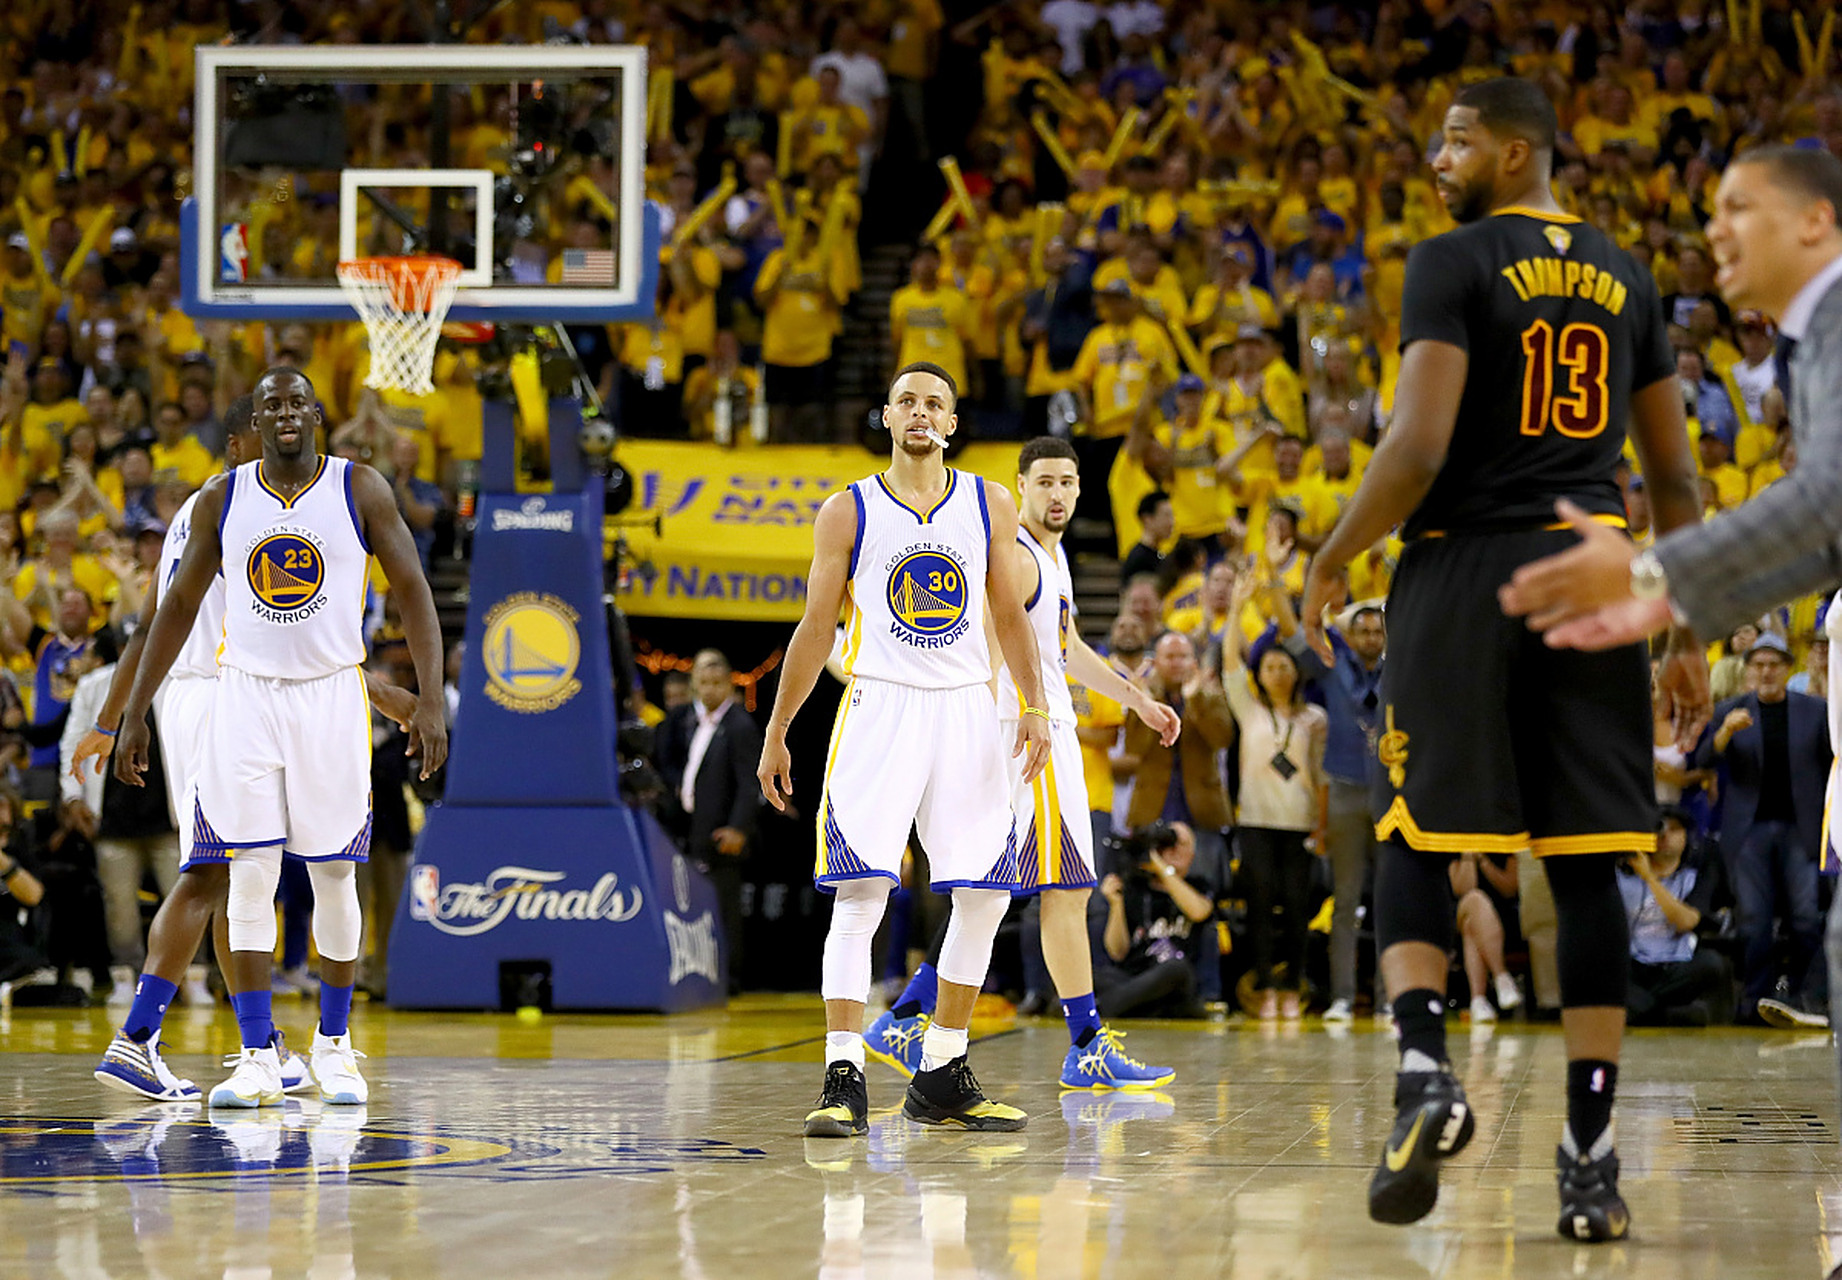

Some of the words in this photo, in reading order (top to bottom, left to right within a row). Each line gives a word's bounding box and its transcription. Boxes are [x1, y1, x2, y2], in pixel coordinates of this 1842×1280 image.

[1501, 256, 1627, 316] THOMPSON
[1519, 318, 1610, 439] 13
[245, 525, 288, 553] GOLDEN
[293, 526, 325, 549] STATE
[284, 549, 312, 569] 23
[885, 543, 931, 571] GOLDEN
[936, 544, 969, 569] STATE
[928, 571, 957, 592] 30
[252, 594, 328, 623] WARRIORS
[890, 619, 969, 649] WARRIORS
[438, 883, 500, 920] The
[470, 866, 643, 932] Finals
